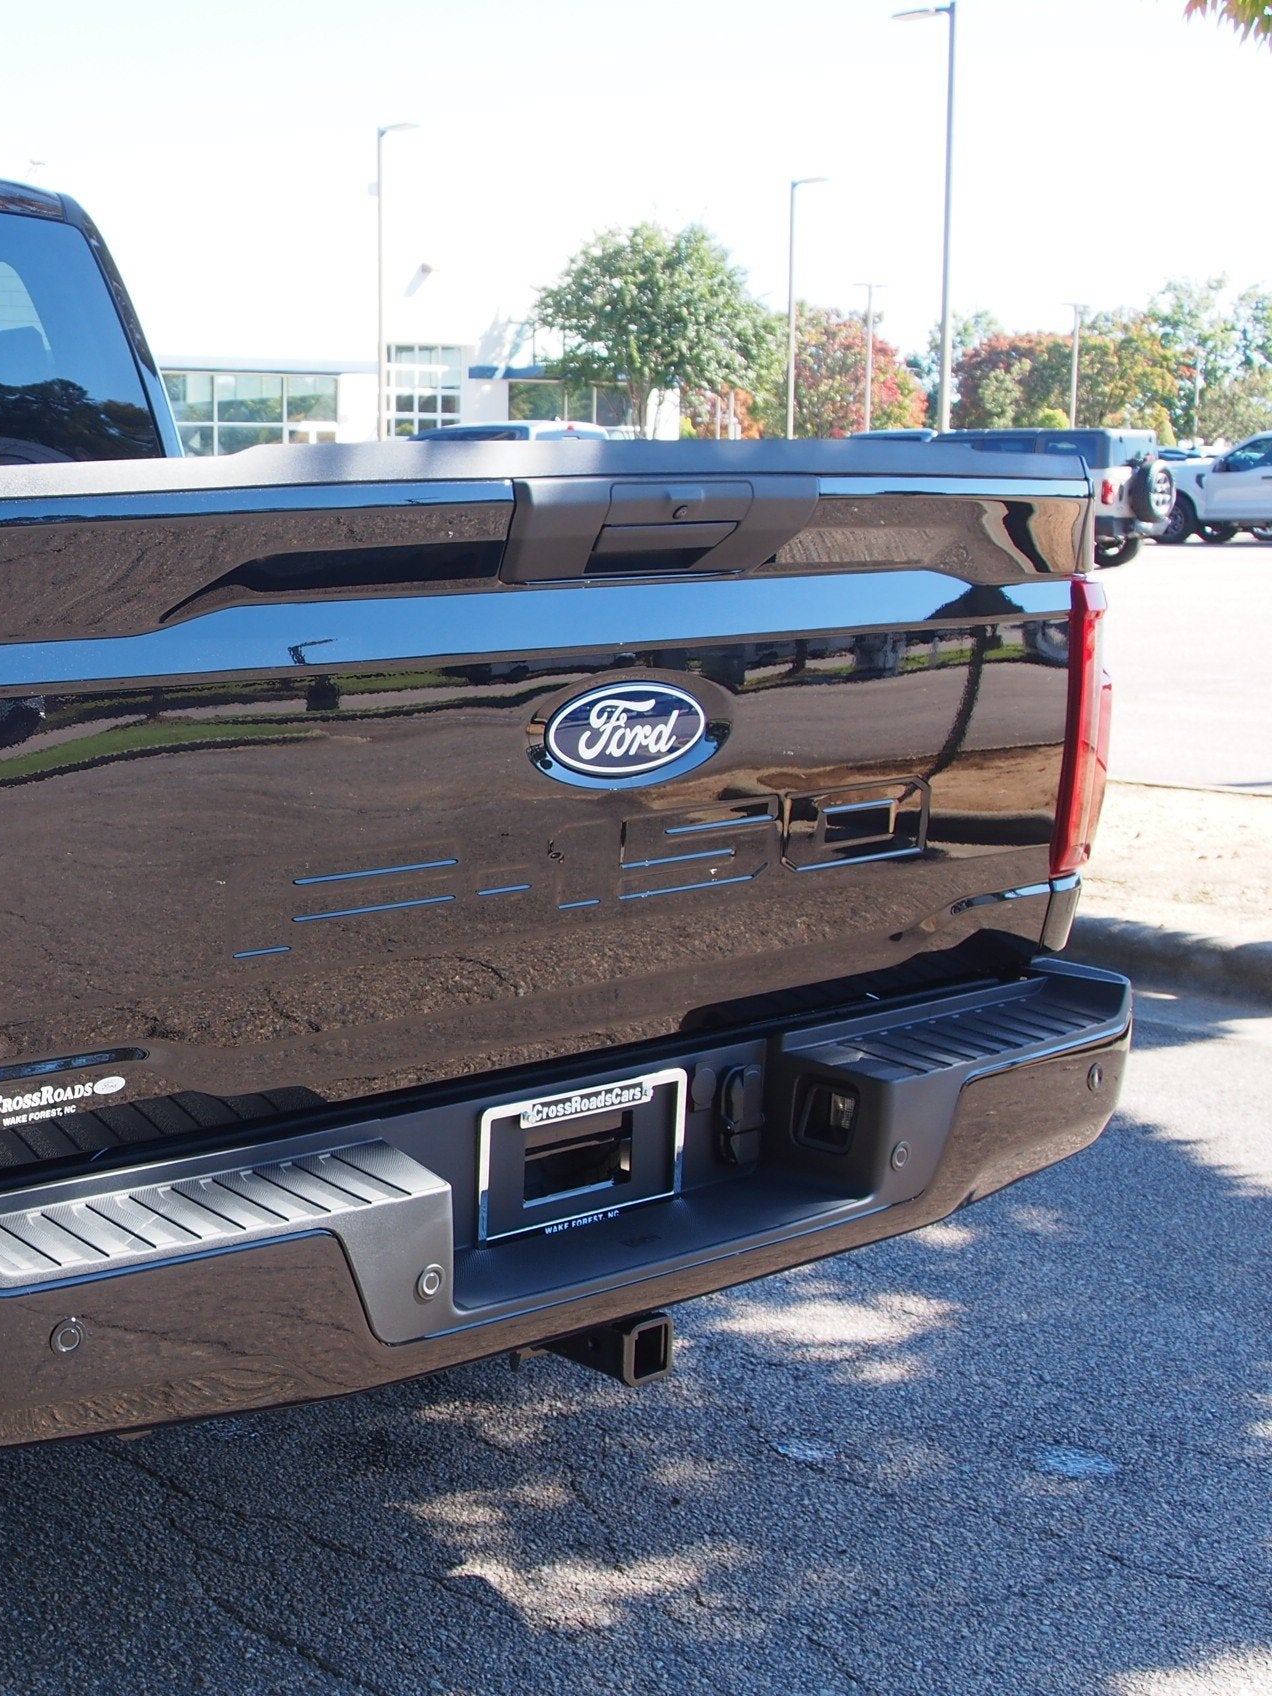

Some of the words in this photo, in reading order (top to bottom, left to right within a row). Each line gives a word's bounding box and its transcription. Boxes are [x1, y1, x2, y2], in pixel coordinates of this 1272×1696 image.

[578, 698, 680, 760] Ford
[2, 1114, 28, 1127] WAKE
[28, 1107, 64, 1122] FOREST,
[64, 1104, 77, 1115] NC
[531, 1086, 642, 1122] CrossRoadsCars
[544, 1222, 570, 1235] WAKE
[608, 1209, 620, 1219] NC
